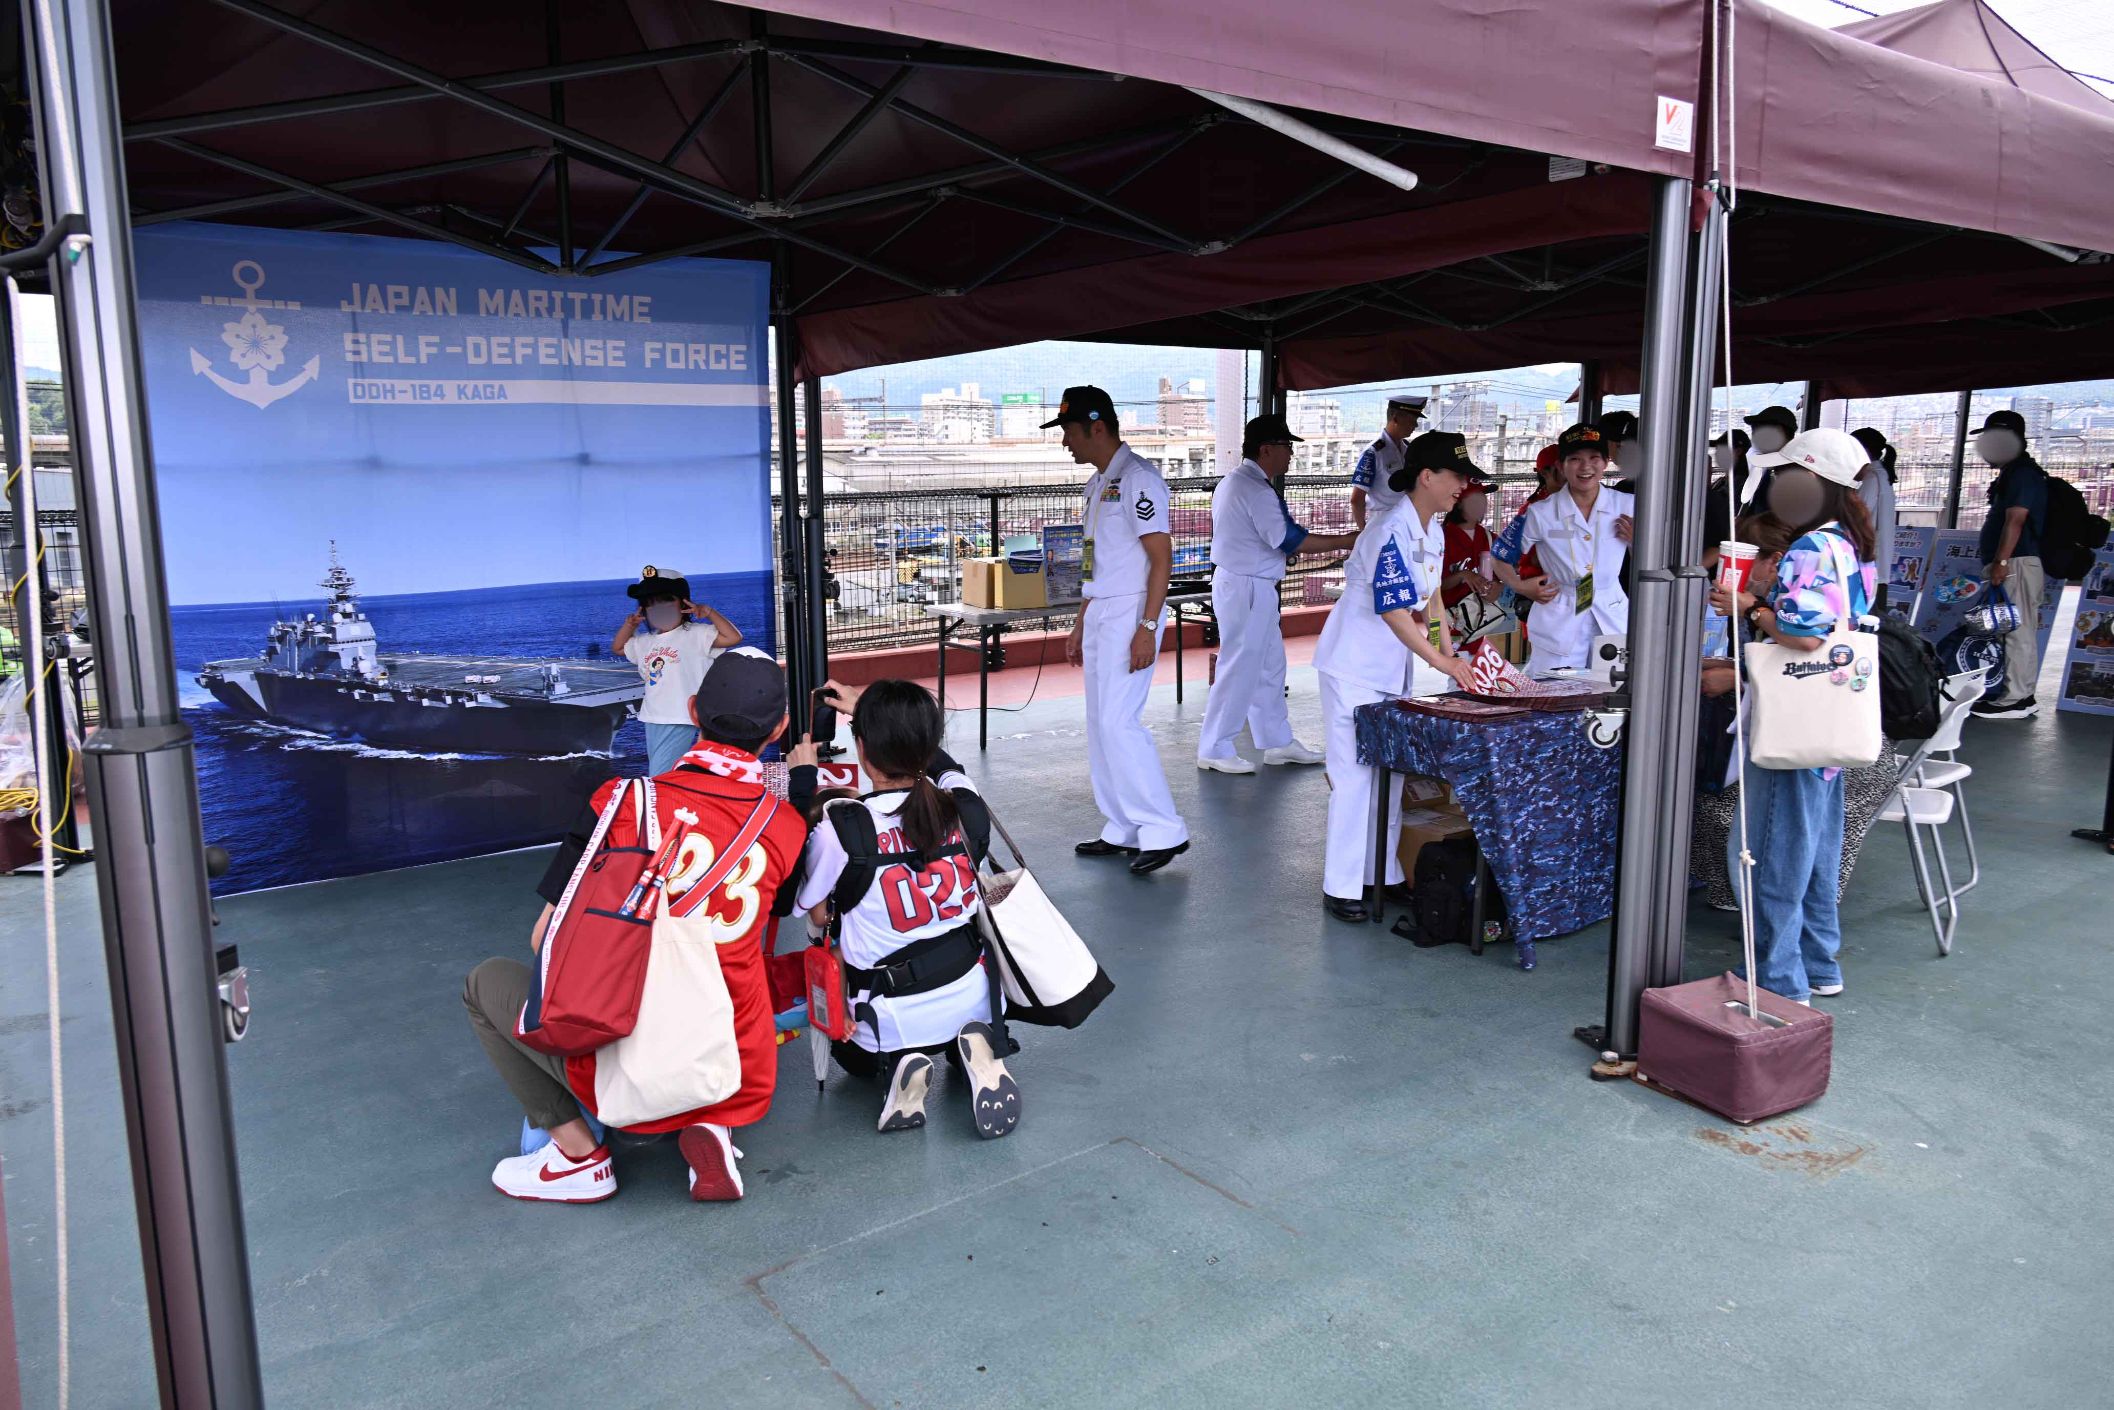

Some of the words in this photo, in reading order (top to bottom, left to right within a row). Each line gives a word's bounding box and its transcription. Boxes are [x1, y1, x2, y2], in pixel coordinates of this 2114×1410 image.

[340, 282, 458, 317] JAPAN
[478, 288, 652, 323] MARITIME
[343, 332, 626, 367] SELF-DEFENSE
[645, 341, 748, 370] FORCE
[353, 383, 446, 400] DDH-184
[457, 384, 508, 400] KAGA
[1382, 588, 1412, 606] 広報
